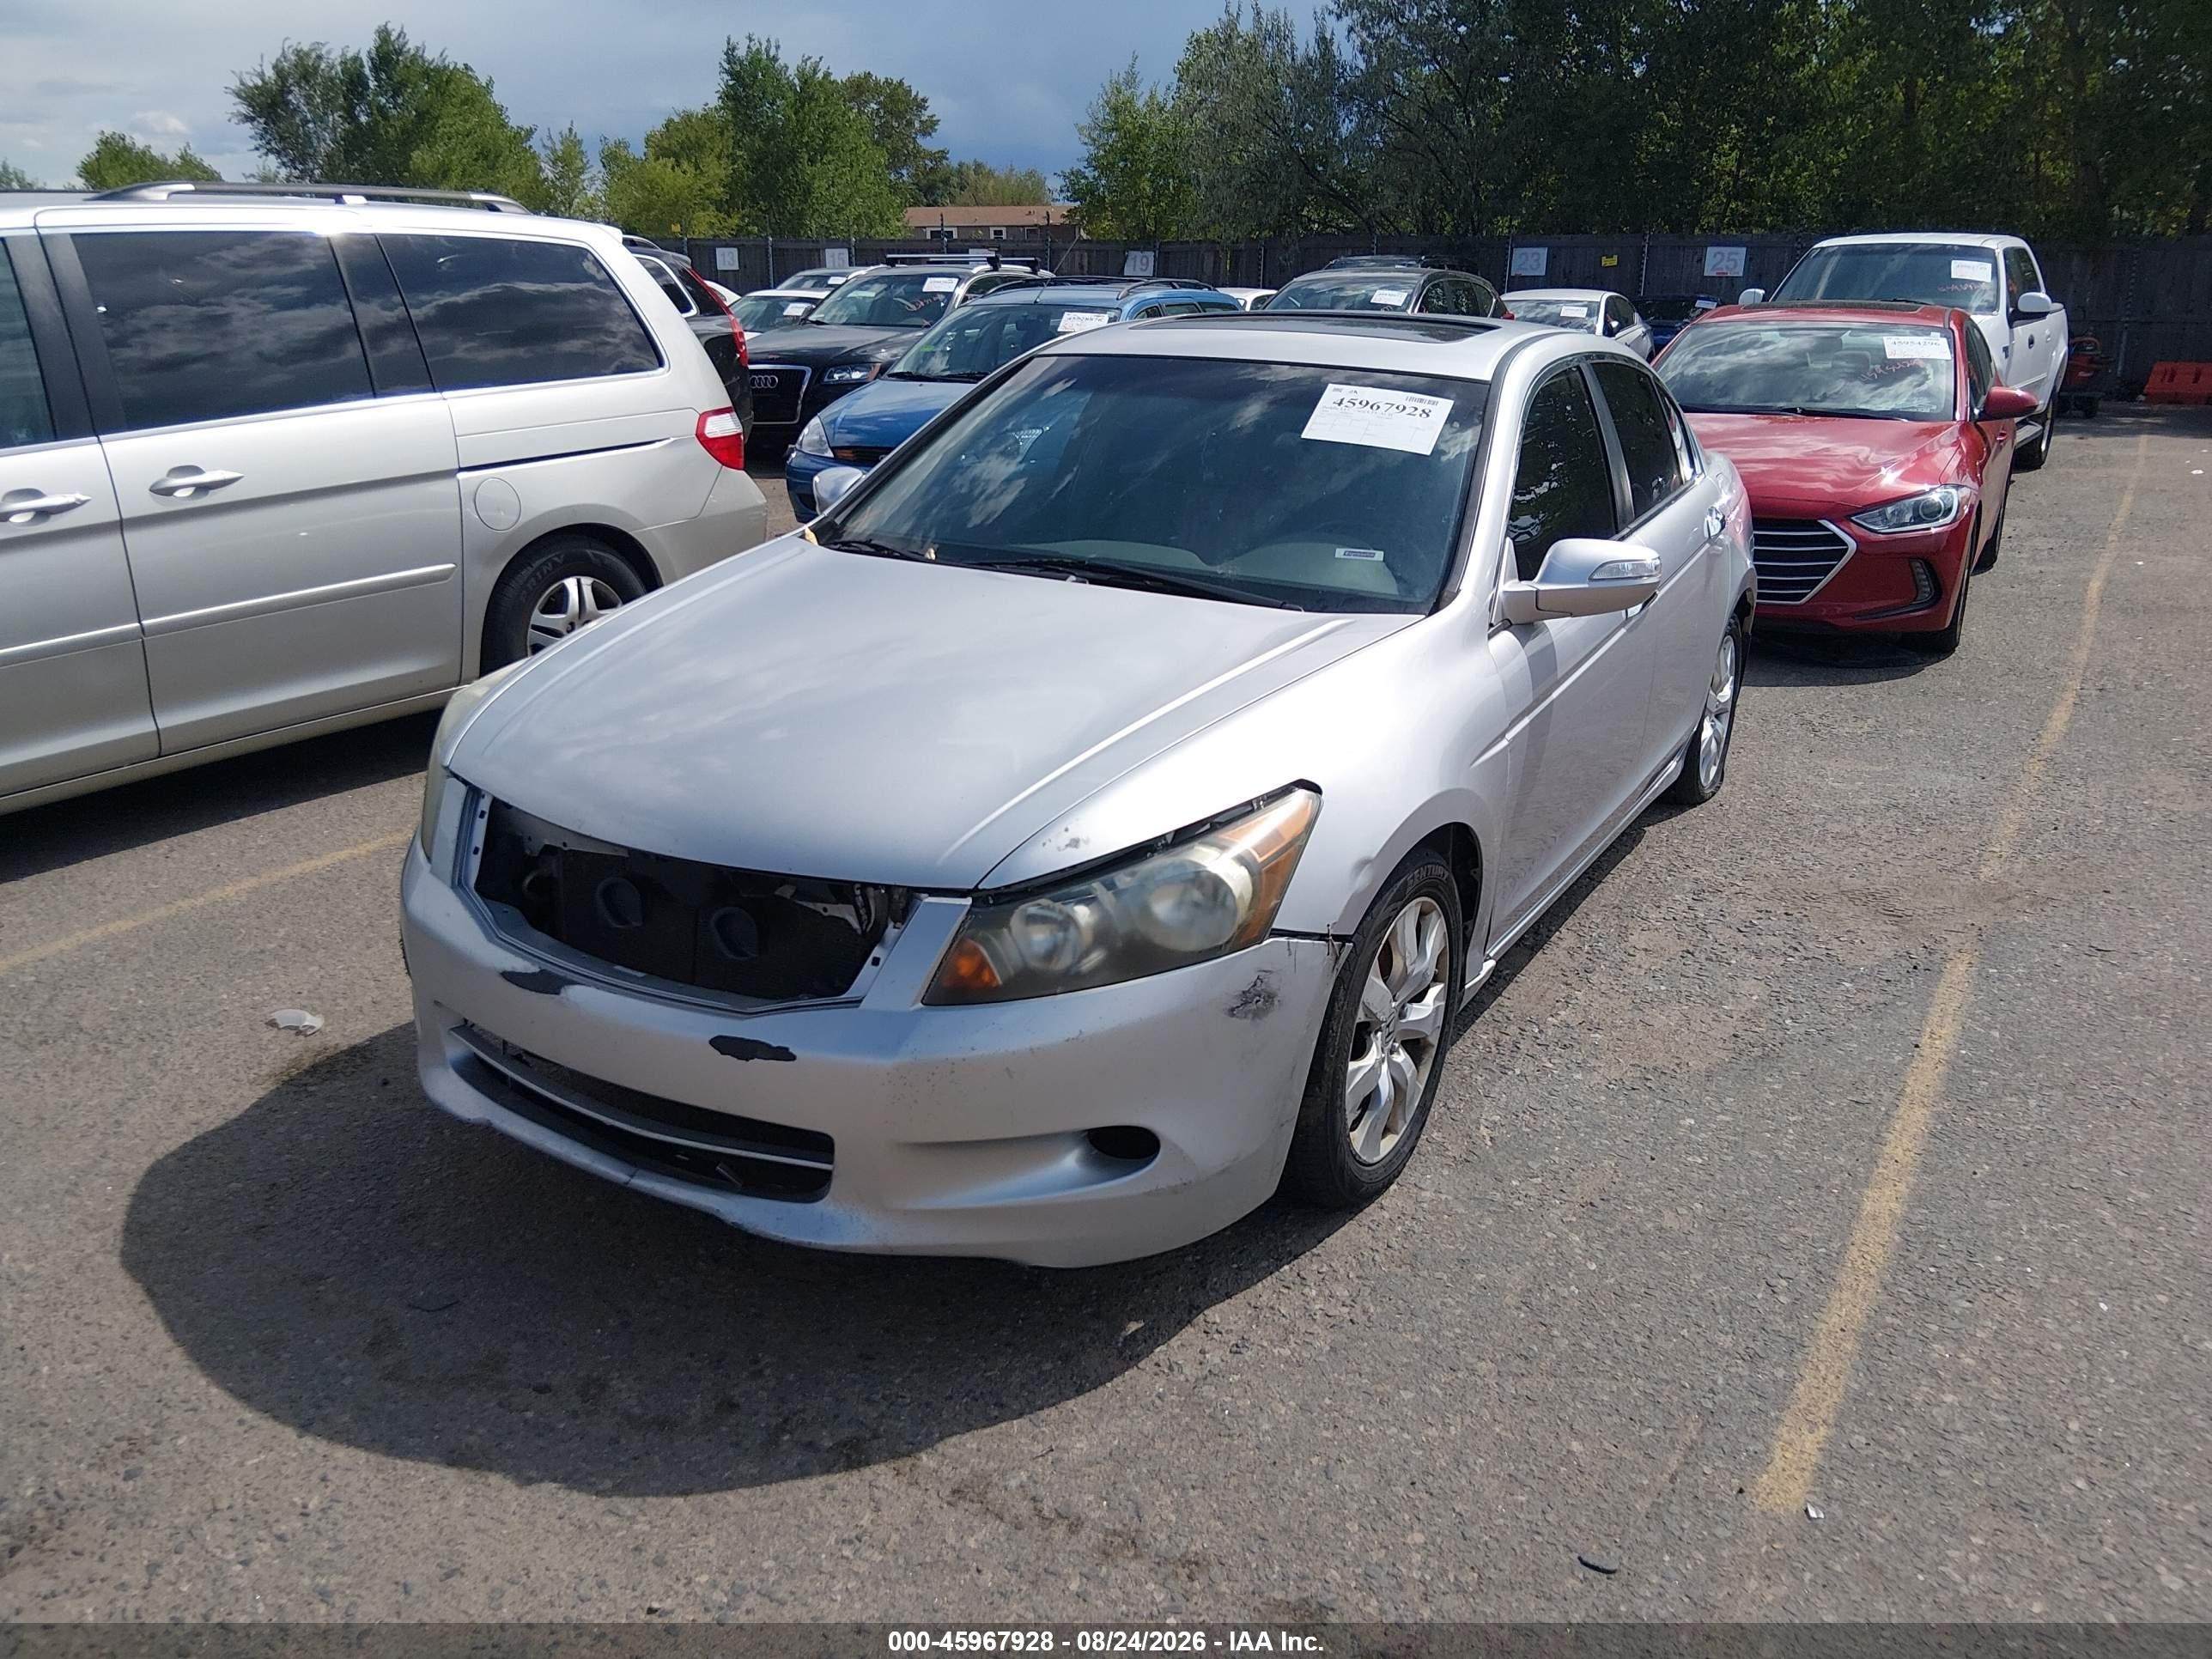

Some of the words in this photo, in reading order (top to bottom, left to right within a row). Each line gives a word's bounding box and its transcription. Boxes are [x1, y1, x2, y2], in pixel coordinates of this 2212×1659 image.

[720, 252, 735, 266] 13
[830, 252, 845, 268] 15
[1131, 254, 1150, 272] 19
[1517, 252, 1541, 270] 23
[1711, 251, 1739, 272] 25
[1332, 396, 1432, 419] 45967928
